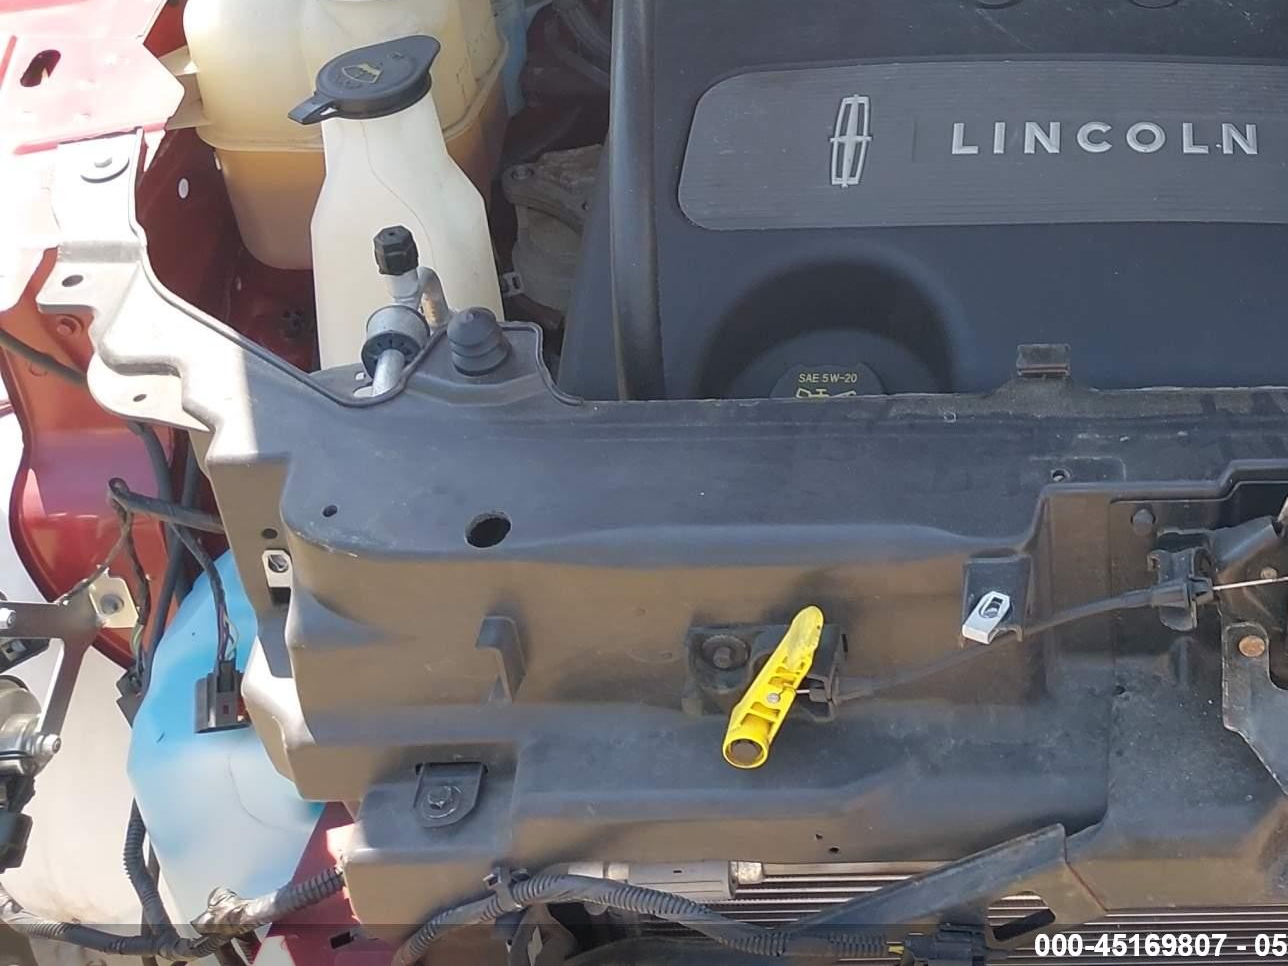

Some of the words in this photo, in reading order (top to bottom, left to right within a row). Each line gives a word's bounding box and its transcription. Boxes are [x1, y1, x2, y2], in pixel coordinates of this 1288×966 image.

[952, 121, 1258, 155] LINCOLN
[798, 373, 820, 384] SAE
[822, 373, 858, 384] 5W-20
